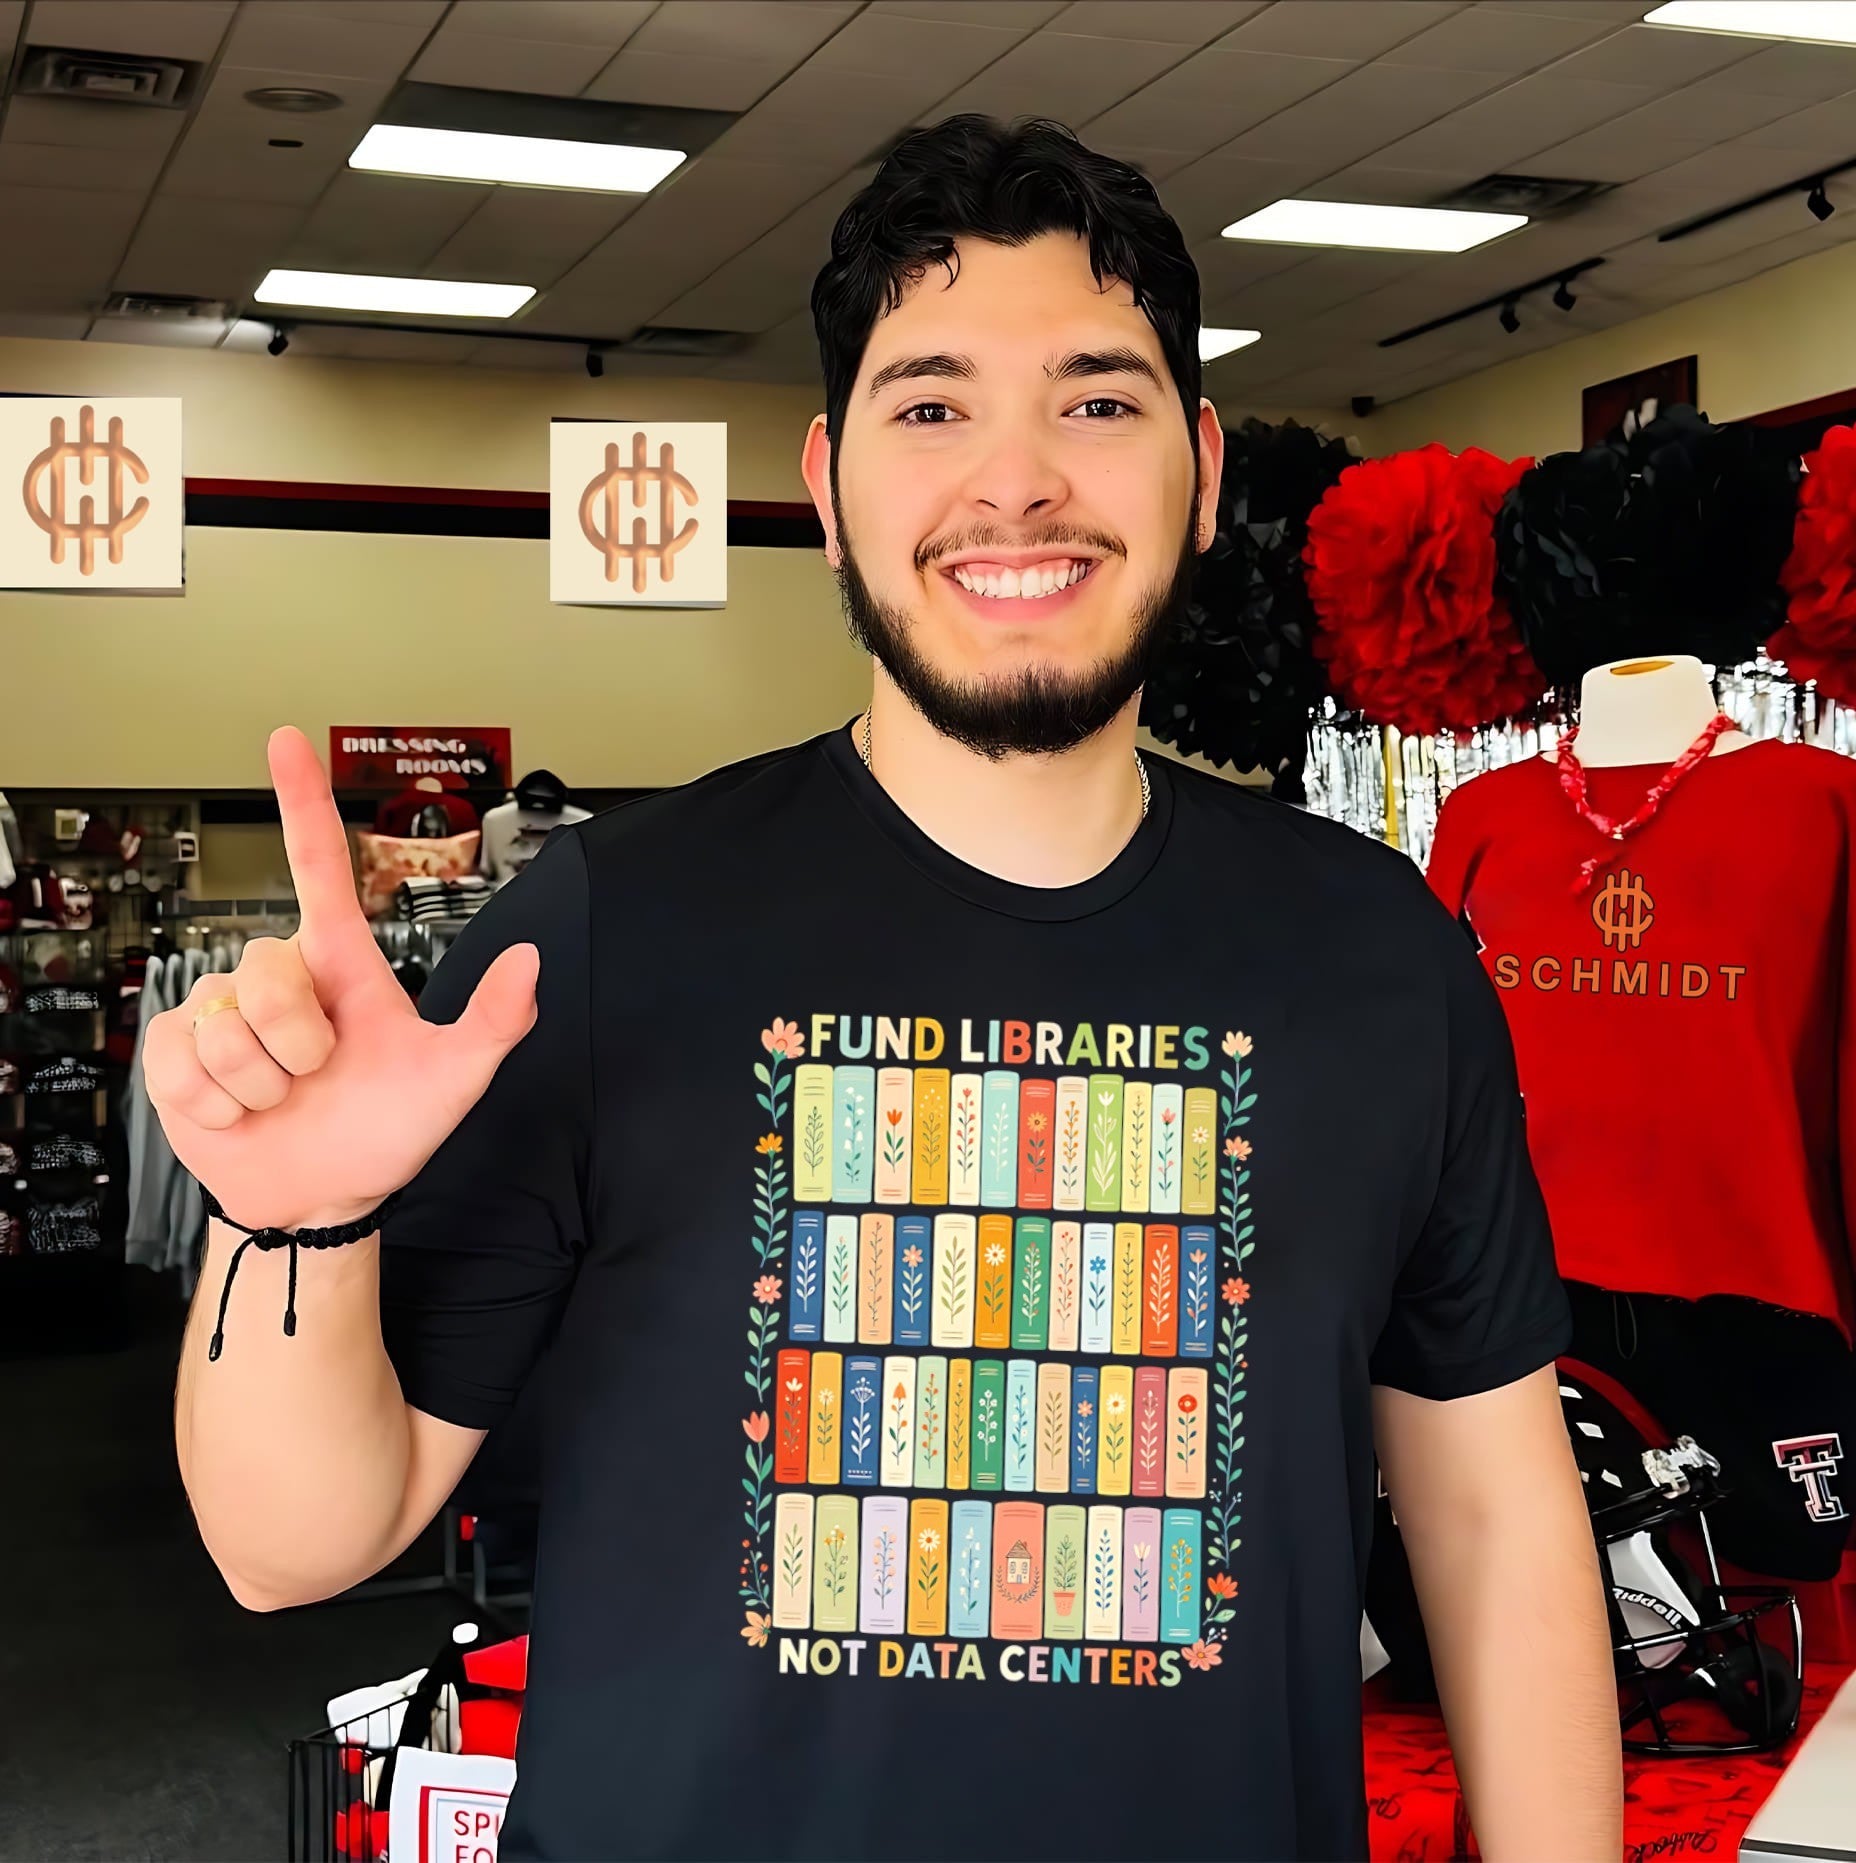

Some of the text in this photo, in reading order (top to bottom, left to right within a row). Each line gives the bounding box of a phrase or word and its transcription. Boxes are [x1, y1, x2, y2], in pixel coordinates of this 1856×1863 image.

[396, 758, 487, 775] ROOMS
[1494, 954, 1747, 1001] SCHMIDT
[810, 1013, 1210, 1071] FUND LIBRARIES
[778, 1637, 1182, 1688] NOT DATA CENTERS
